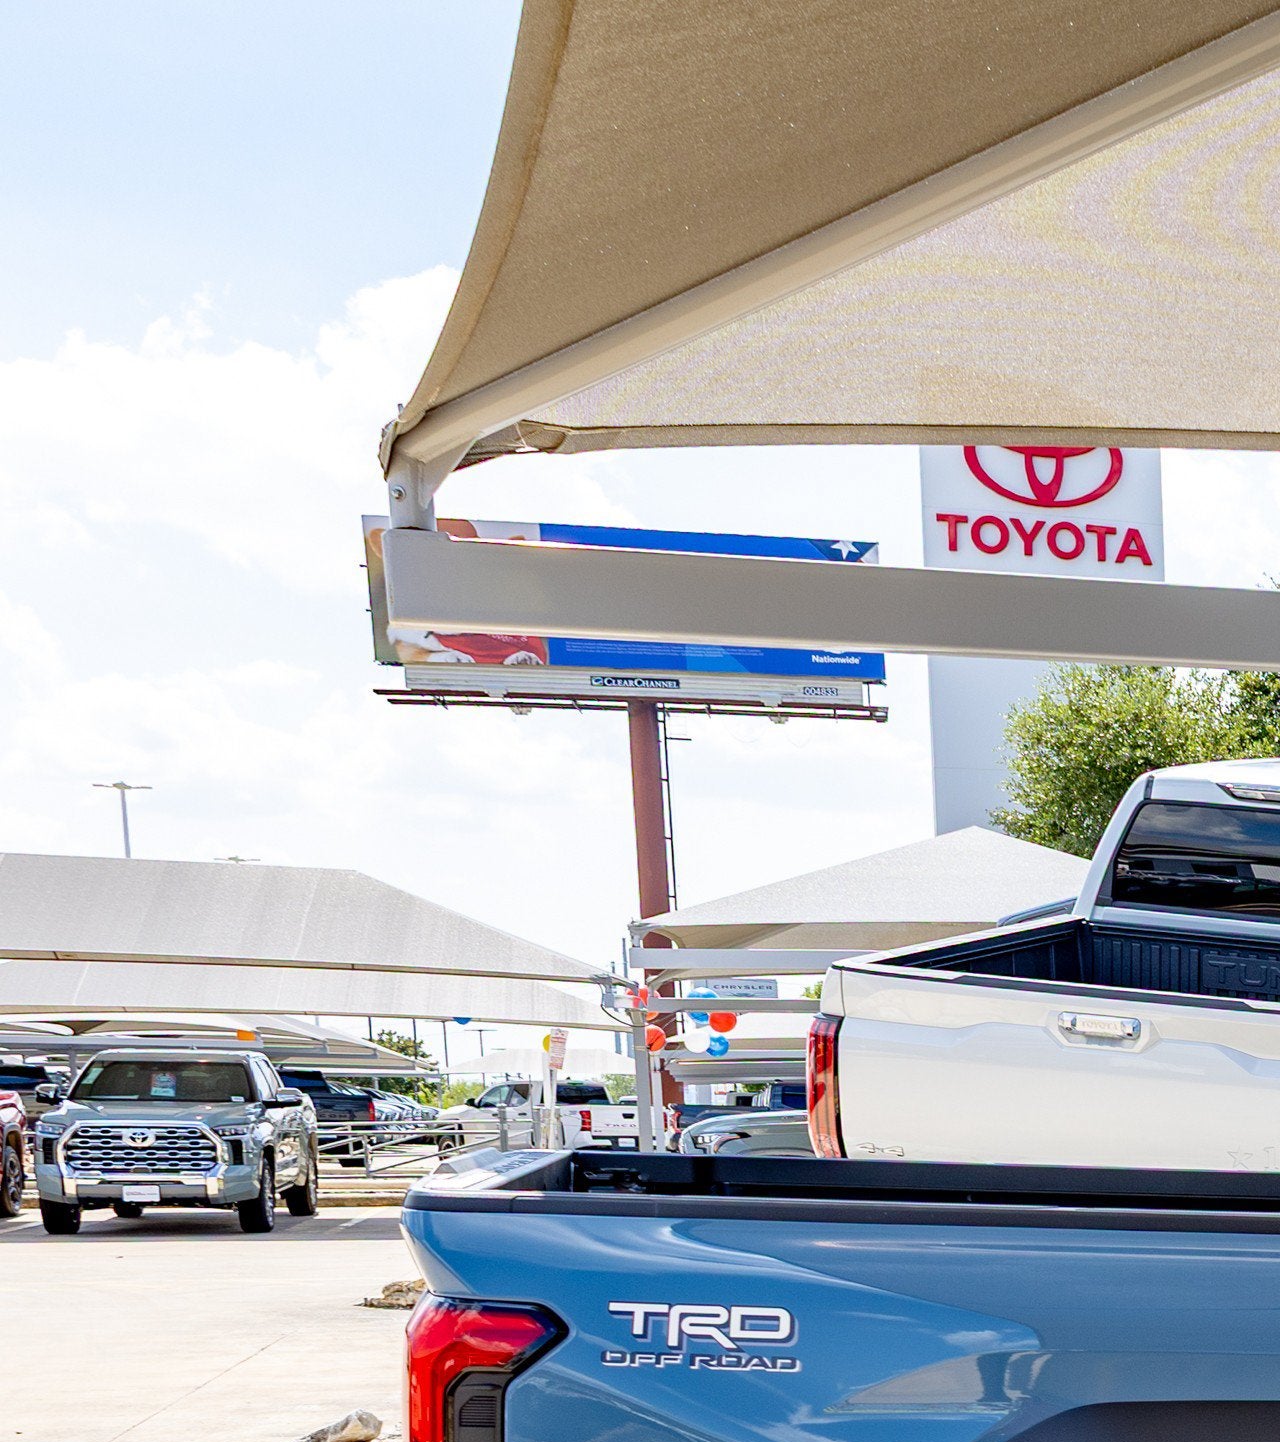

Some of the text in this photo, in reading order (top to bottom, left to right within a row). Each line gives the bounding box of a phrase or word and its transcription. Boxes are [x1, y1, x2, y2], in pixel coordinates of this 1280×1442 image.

[936, 513, 1153, 566] TOYOTA
[1081, 1019, 1119, 1031] TOYOTA
[608, 1301, 798, 1353] TRD
[600, 1350, 802, 1373] OFF ROAD
